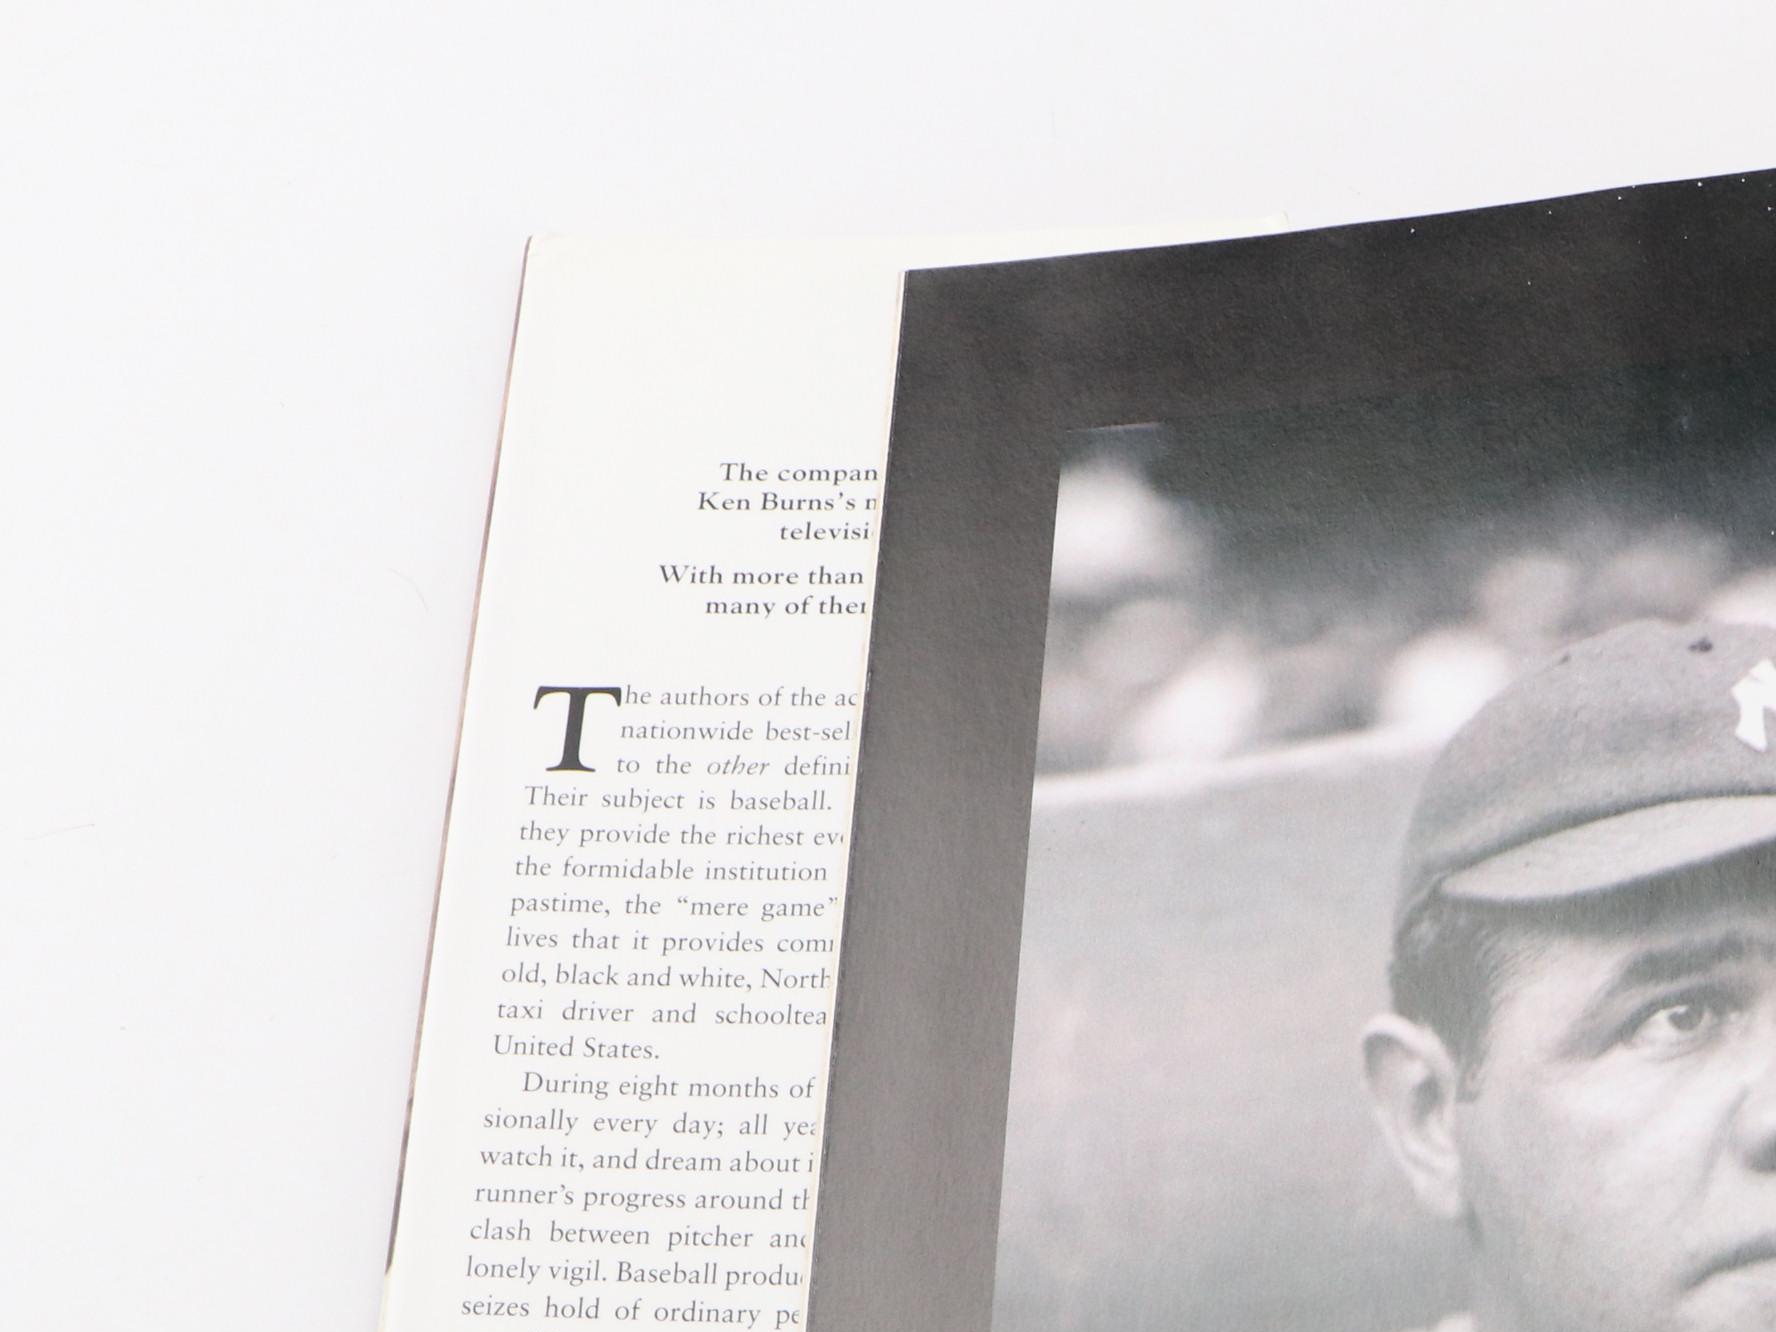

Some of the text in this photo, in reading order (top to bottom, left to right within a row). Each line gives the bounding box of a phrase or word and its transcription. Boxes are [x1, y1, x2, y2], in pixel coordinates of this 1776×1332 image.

[720, 463, 877, 486] The compan
[698, 492, 750, 510] Ken
[781, 521, 876, 540] televisi
[660, 565, 863, 584] With more than
[706, 602, 775, 618] many
[660, 686, 748, 705] authors
[621, 721, 753, 740] nationwide
[618, 759, 640, 772] to
[707, 755, 770, 775] other
[525, 786, 831, 812] Their subject baseball.
[521, 820, 804, 847] they provide richest
[564, 856, 826, 880] formidable institution
[511, 893, 610, 916] pastime,
[626, 894, 661, 914] the
[507, 926, 763, 956] lives that it provides
[502, 962, 546, 986] old,
[556, 963, 618, 985] black
[680, 966, 751, 991] white,
[498, 999, 542, 1019] taxi
[562, 1000, 634, 1022] driver
[495, 1035, 659, 1059] United States.
[523, 1072, 778, 1101] During eight months
[484, 1108, 767, 1139] sionally every day; all
[481, 1145, 551, 1166] watch
[562, 1147, 584, 1170] it,
[646, 1149, 720, 1171] dream
[730, 1150, 800, 1172] about
[584, 1192, 685, 1212] progress
[695, 1188, 782, 1210] around
[470, 1218, 753, 1251] clash between pitcher
[467, 1255, 802, 1291] lonely vigil. Baseball produ
[462, 1295, 760, 1329] seizes hold ordinary
